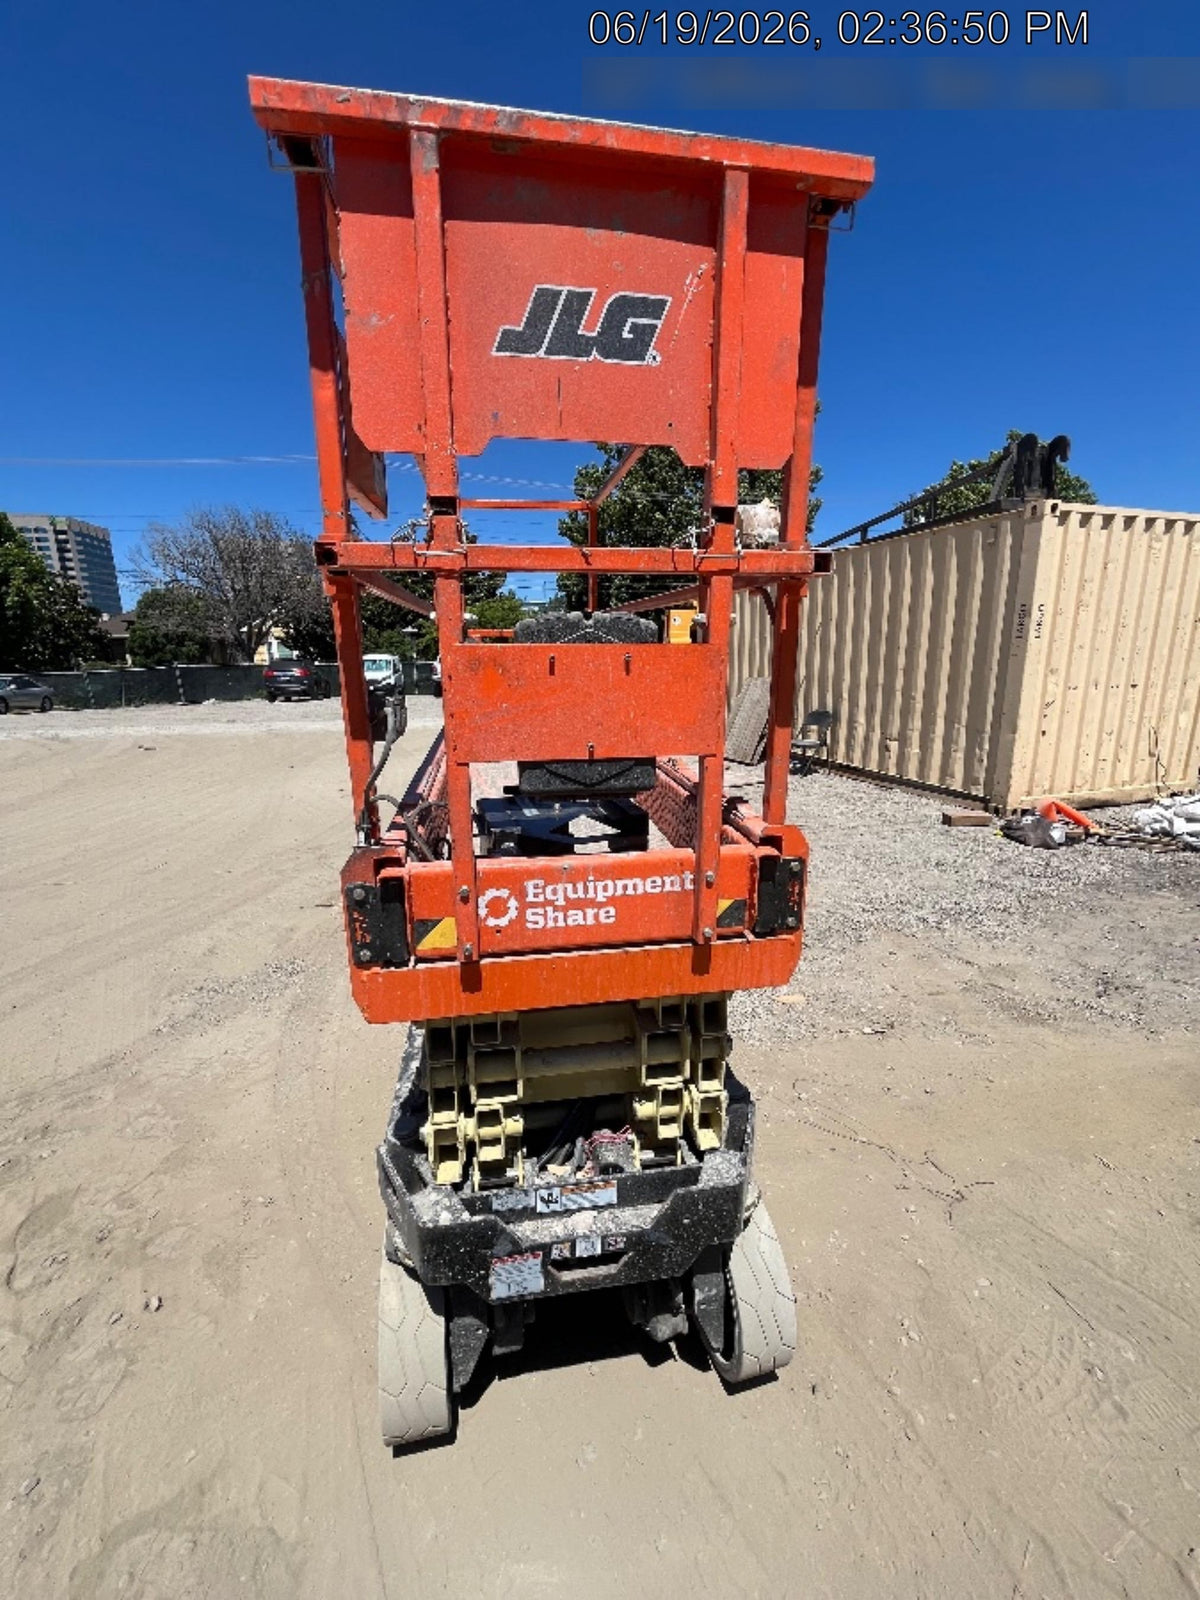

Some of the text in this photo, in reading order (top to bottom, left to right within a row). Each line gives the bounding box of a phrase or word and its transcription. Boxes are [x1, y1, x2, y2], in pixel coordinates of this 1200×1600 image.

[491, 284, 672, 365] JLG
[524, 871, 695, 906] Equipment
[525, 906, 616, 929] Share
